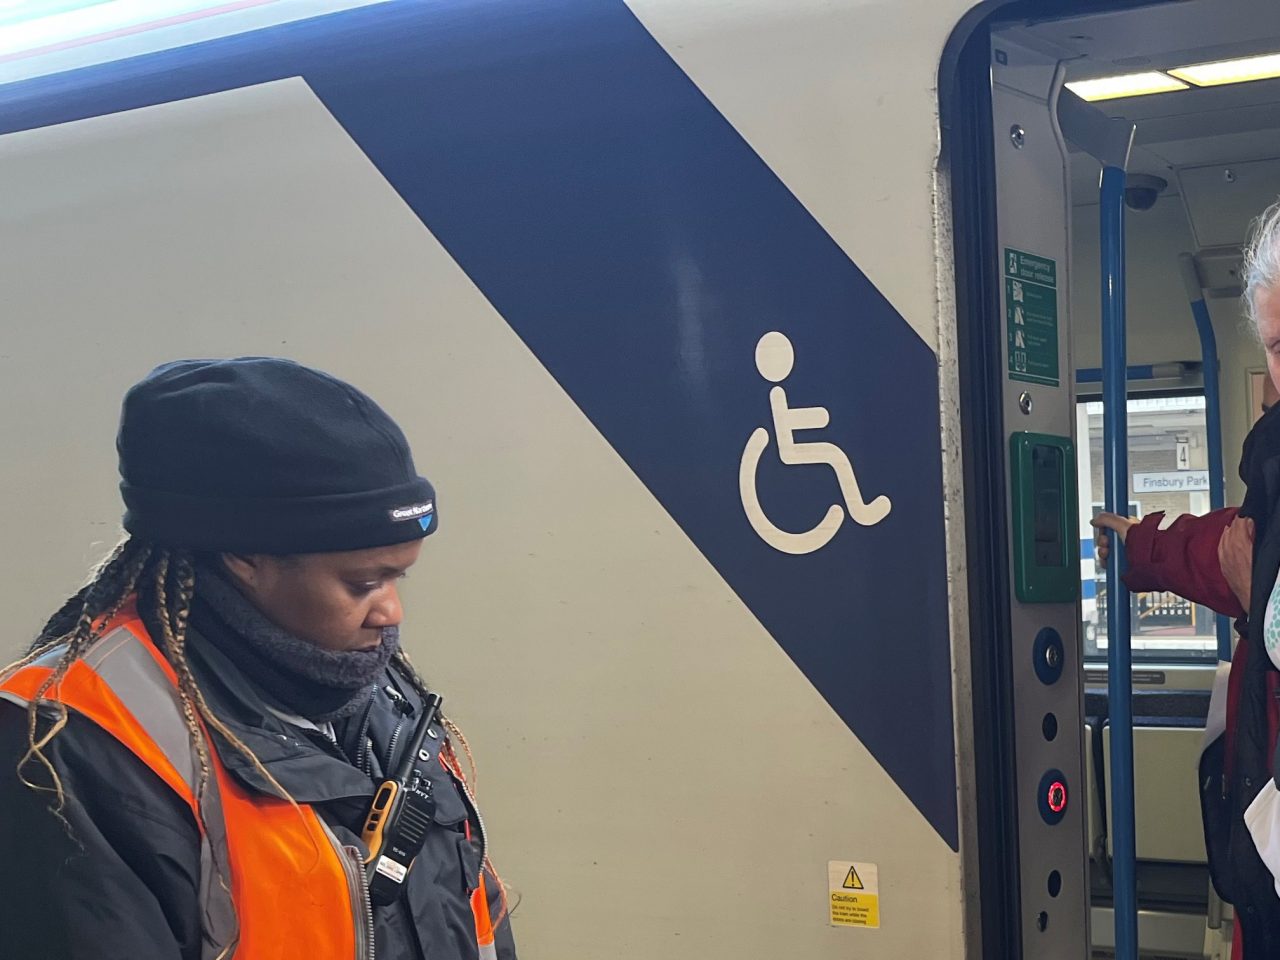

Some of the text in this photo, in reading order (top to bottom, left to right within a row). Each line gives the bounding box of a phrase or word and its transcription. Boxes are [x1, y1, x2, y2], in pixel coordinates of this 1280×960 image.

[1180, 446, 1187, 467] 4
[1143, 475, 1208, 488] Finsbury Park
[831, 893, 858, 904] Caution
